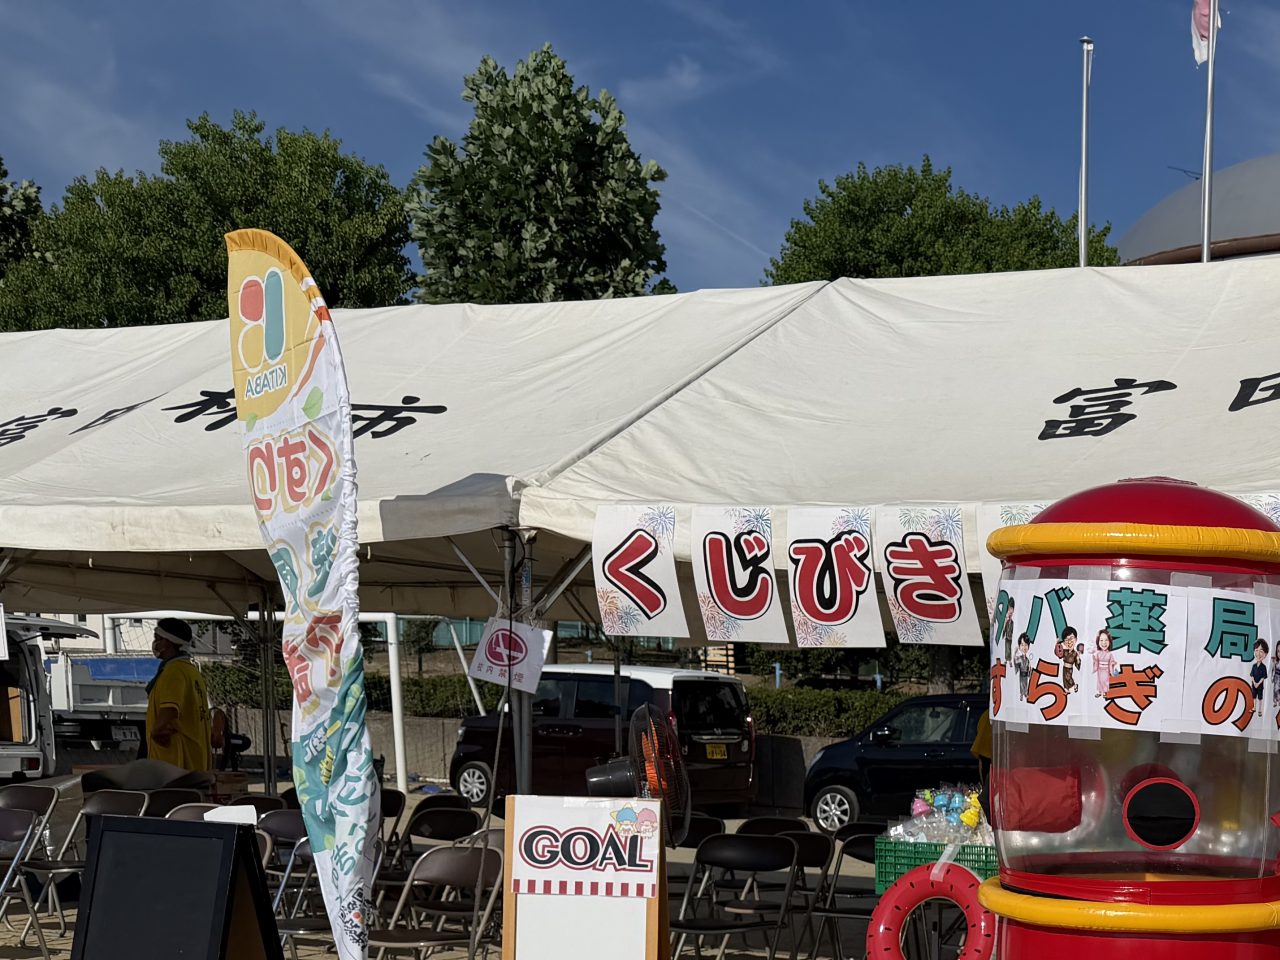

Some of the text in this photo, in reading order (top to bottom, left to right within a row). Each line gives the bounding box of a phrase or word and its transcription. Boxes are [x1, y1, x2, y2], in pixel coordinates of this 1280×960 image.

[601, 526, 964, 627] くじびき
[518, 824, 654, 873] GOAL
